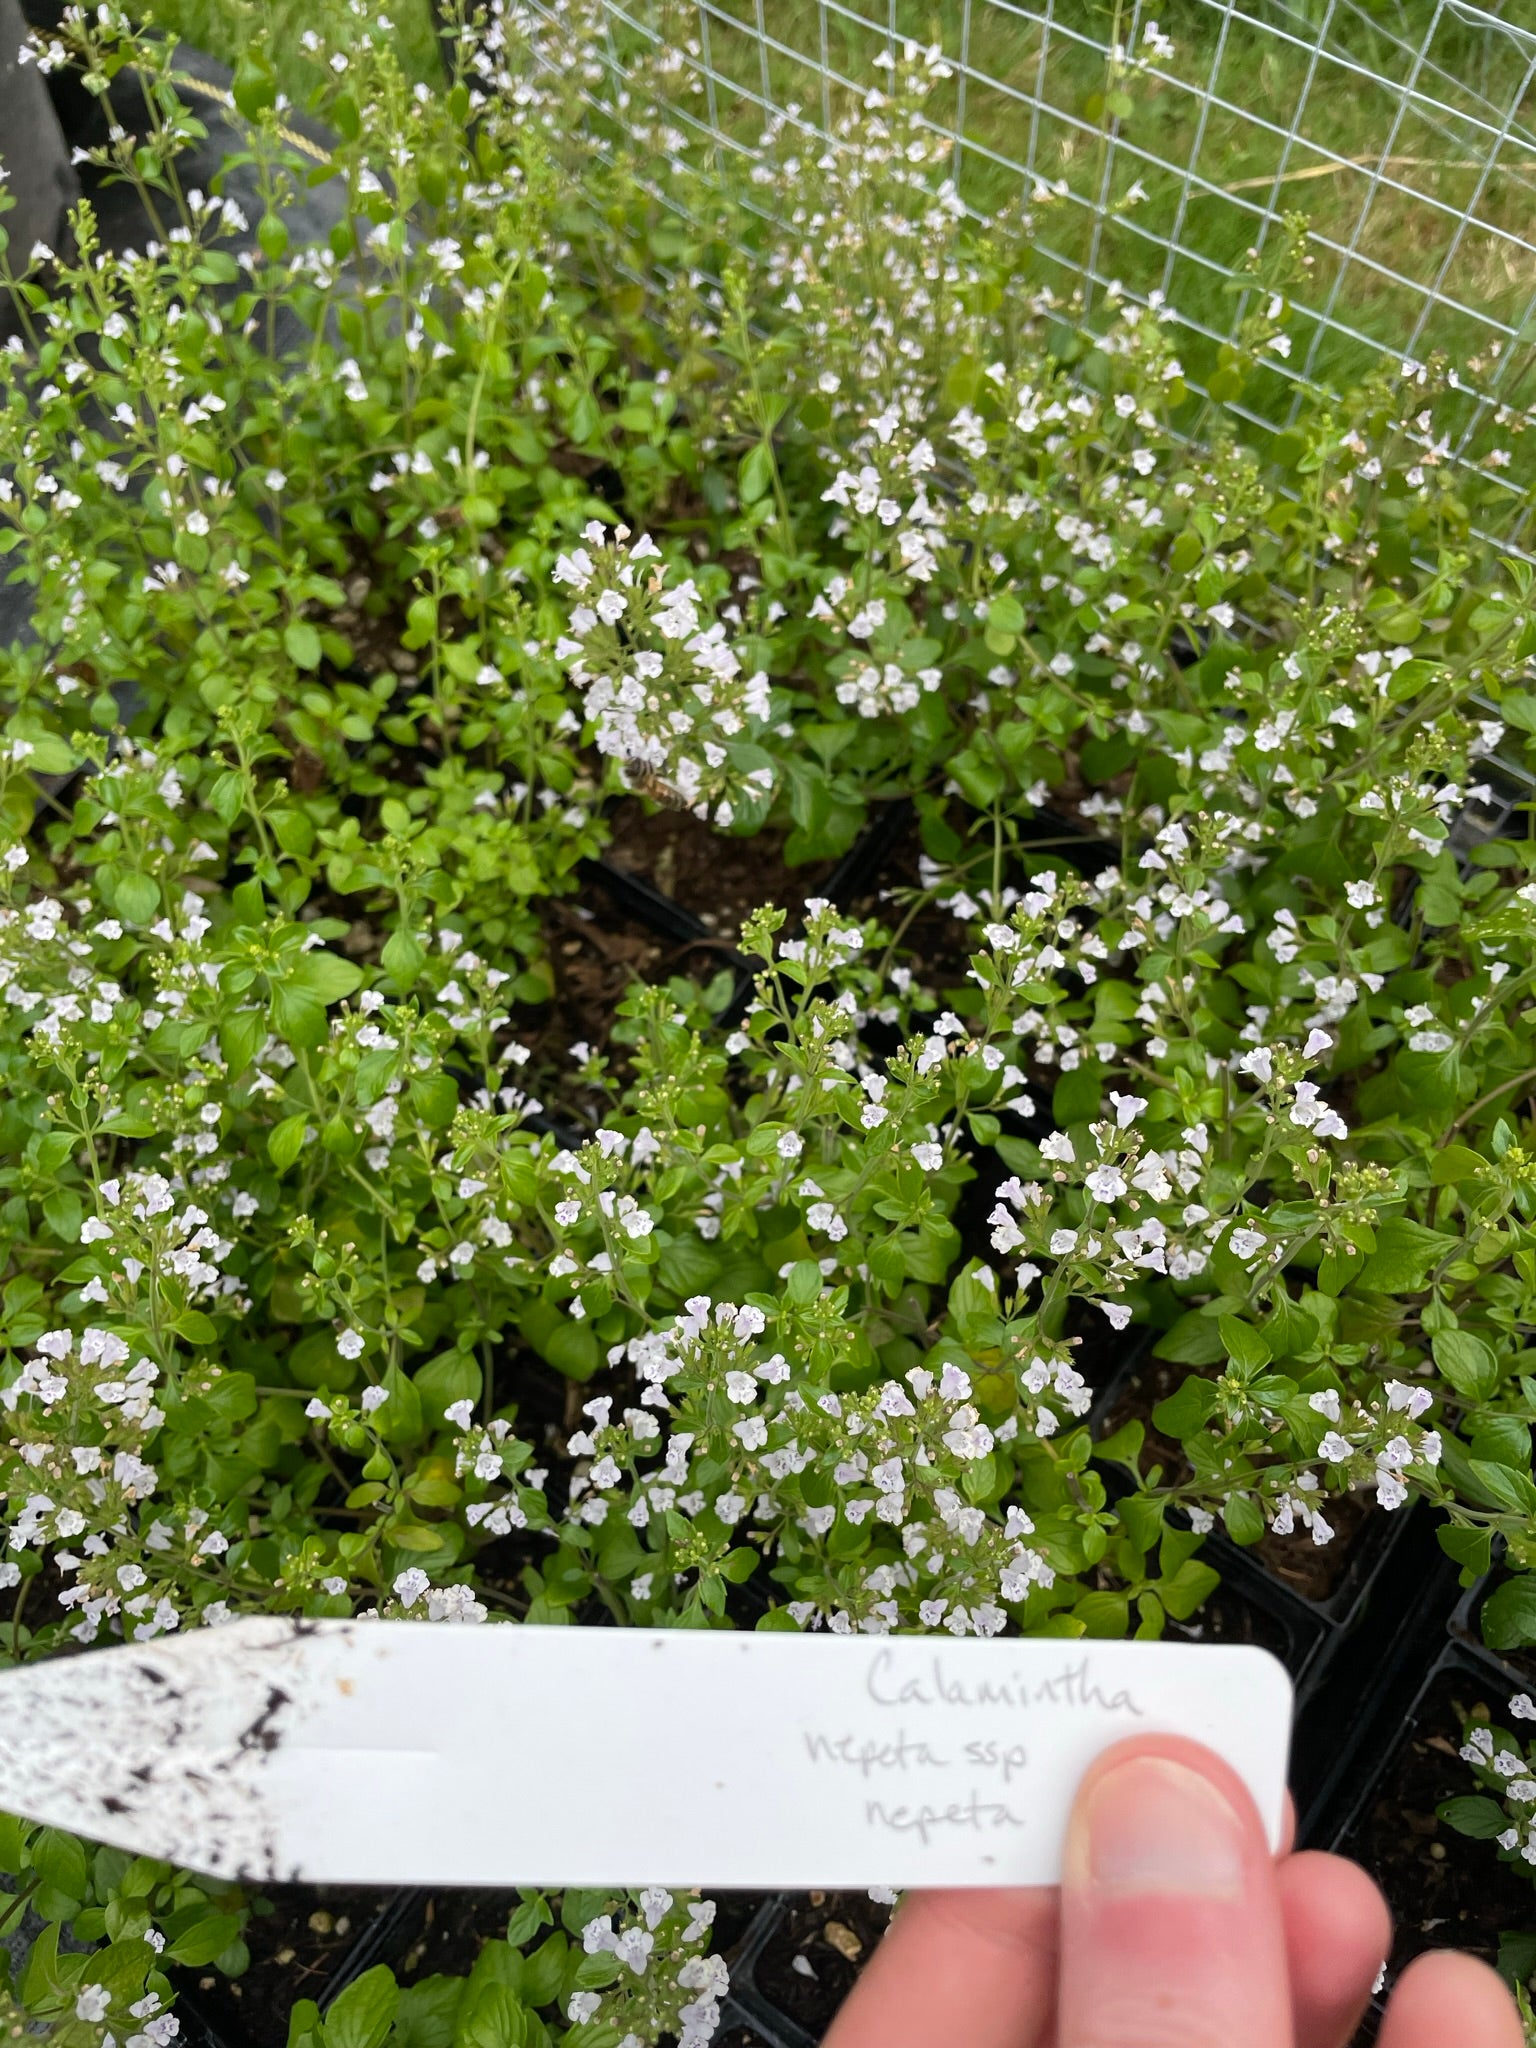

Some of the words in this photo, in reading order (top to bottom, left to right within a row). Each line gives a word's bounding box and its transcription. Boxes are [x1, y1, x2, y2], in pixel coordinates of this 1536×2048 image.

[866, 1648, 1144, 1716] Calamintha
[804, 1729, 948, 1778] nepeta
[964, 1738, 1027, 1783] ssp
[865, 1789, 1025, 1845] nepeta
